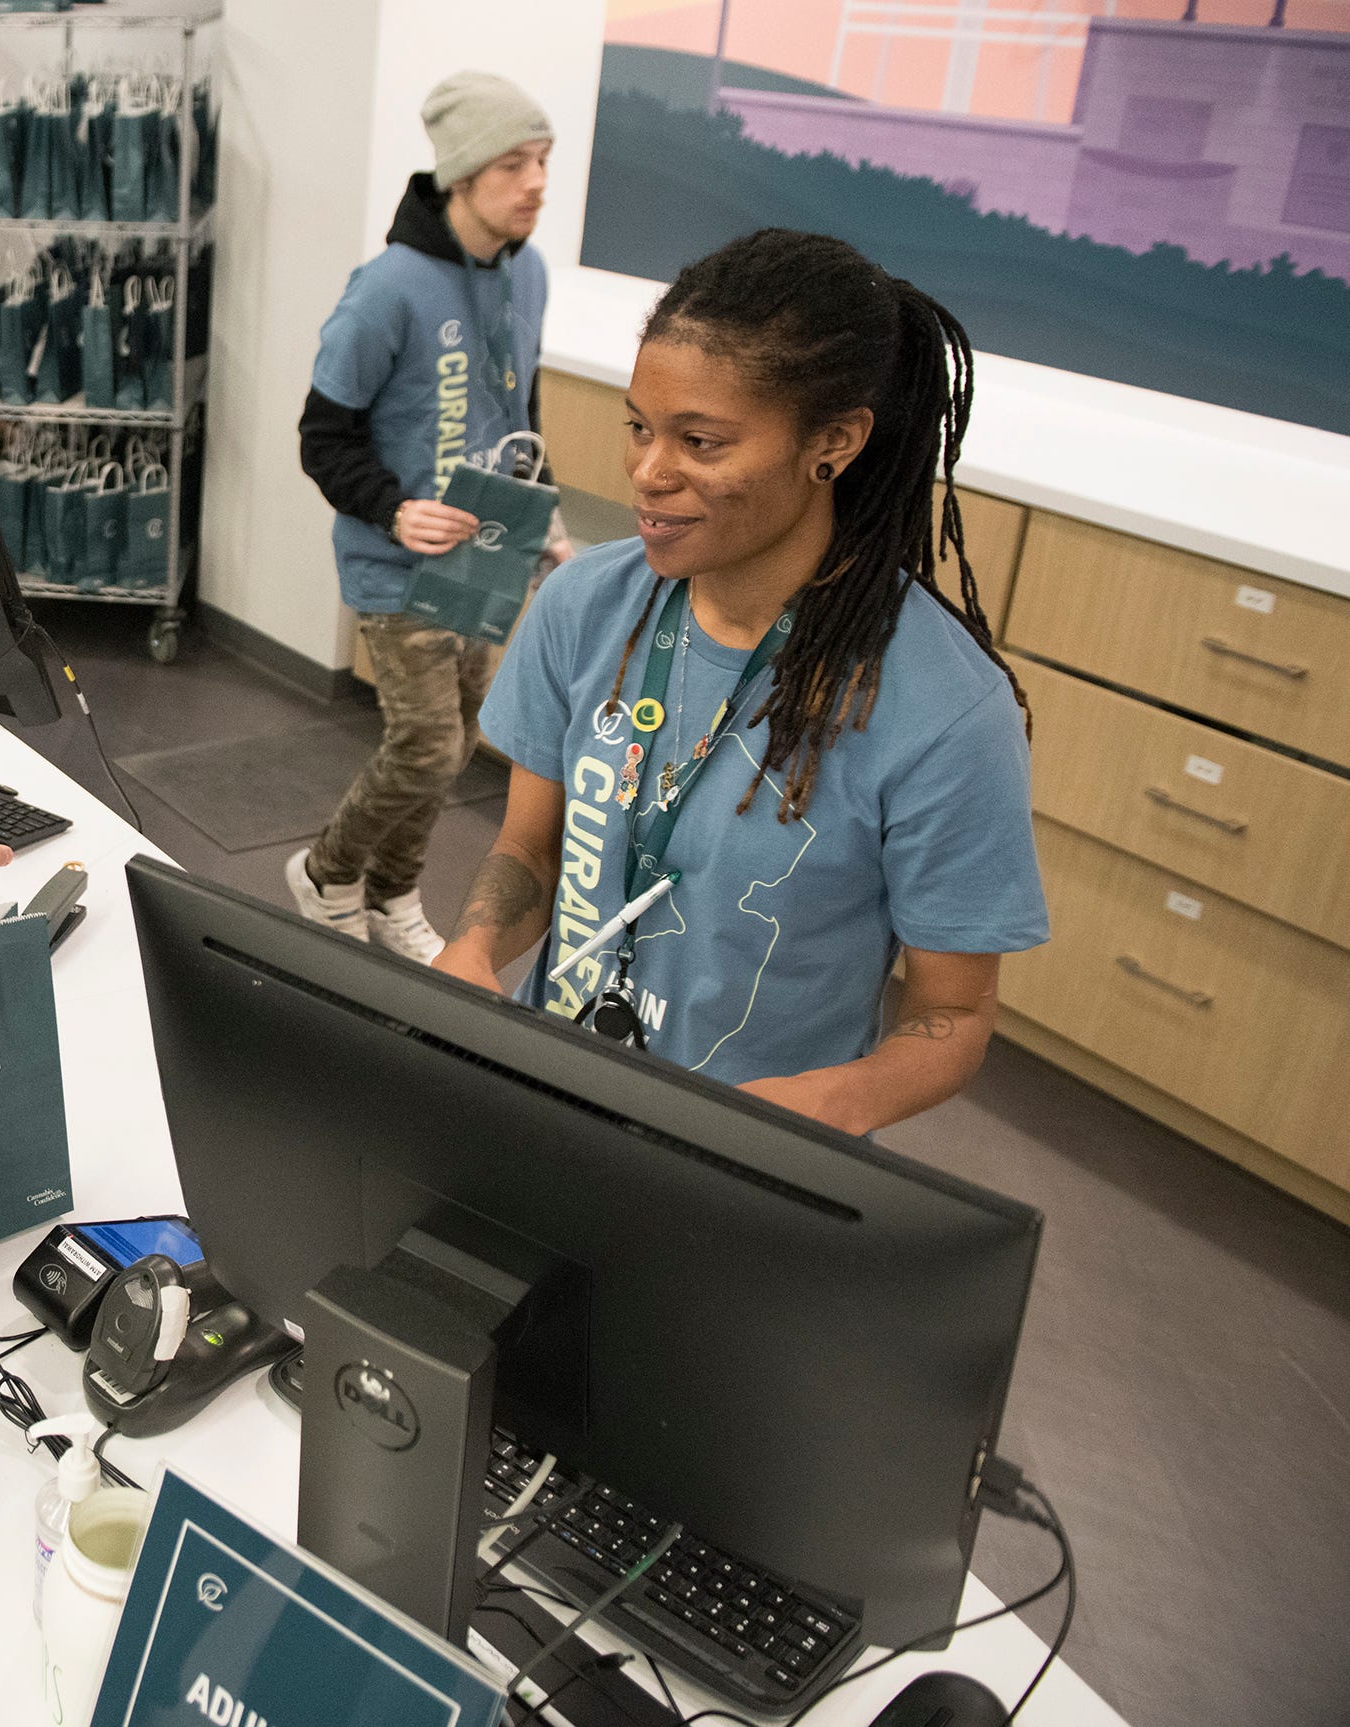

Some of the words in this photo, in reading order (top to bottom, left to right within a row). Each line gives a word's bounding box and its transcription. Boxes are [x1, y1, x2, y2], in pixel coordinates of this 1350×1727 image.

[638, 988, 668, 1031] IN
[62, 1241, 91, 1267] WITHDRAWAL
[89, 1265, 101, 1276] ATM
[344, 1381, 411, 1434] DELL
[186, 1671, 271, 1727] ADU
